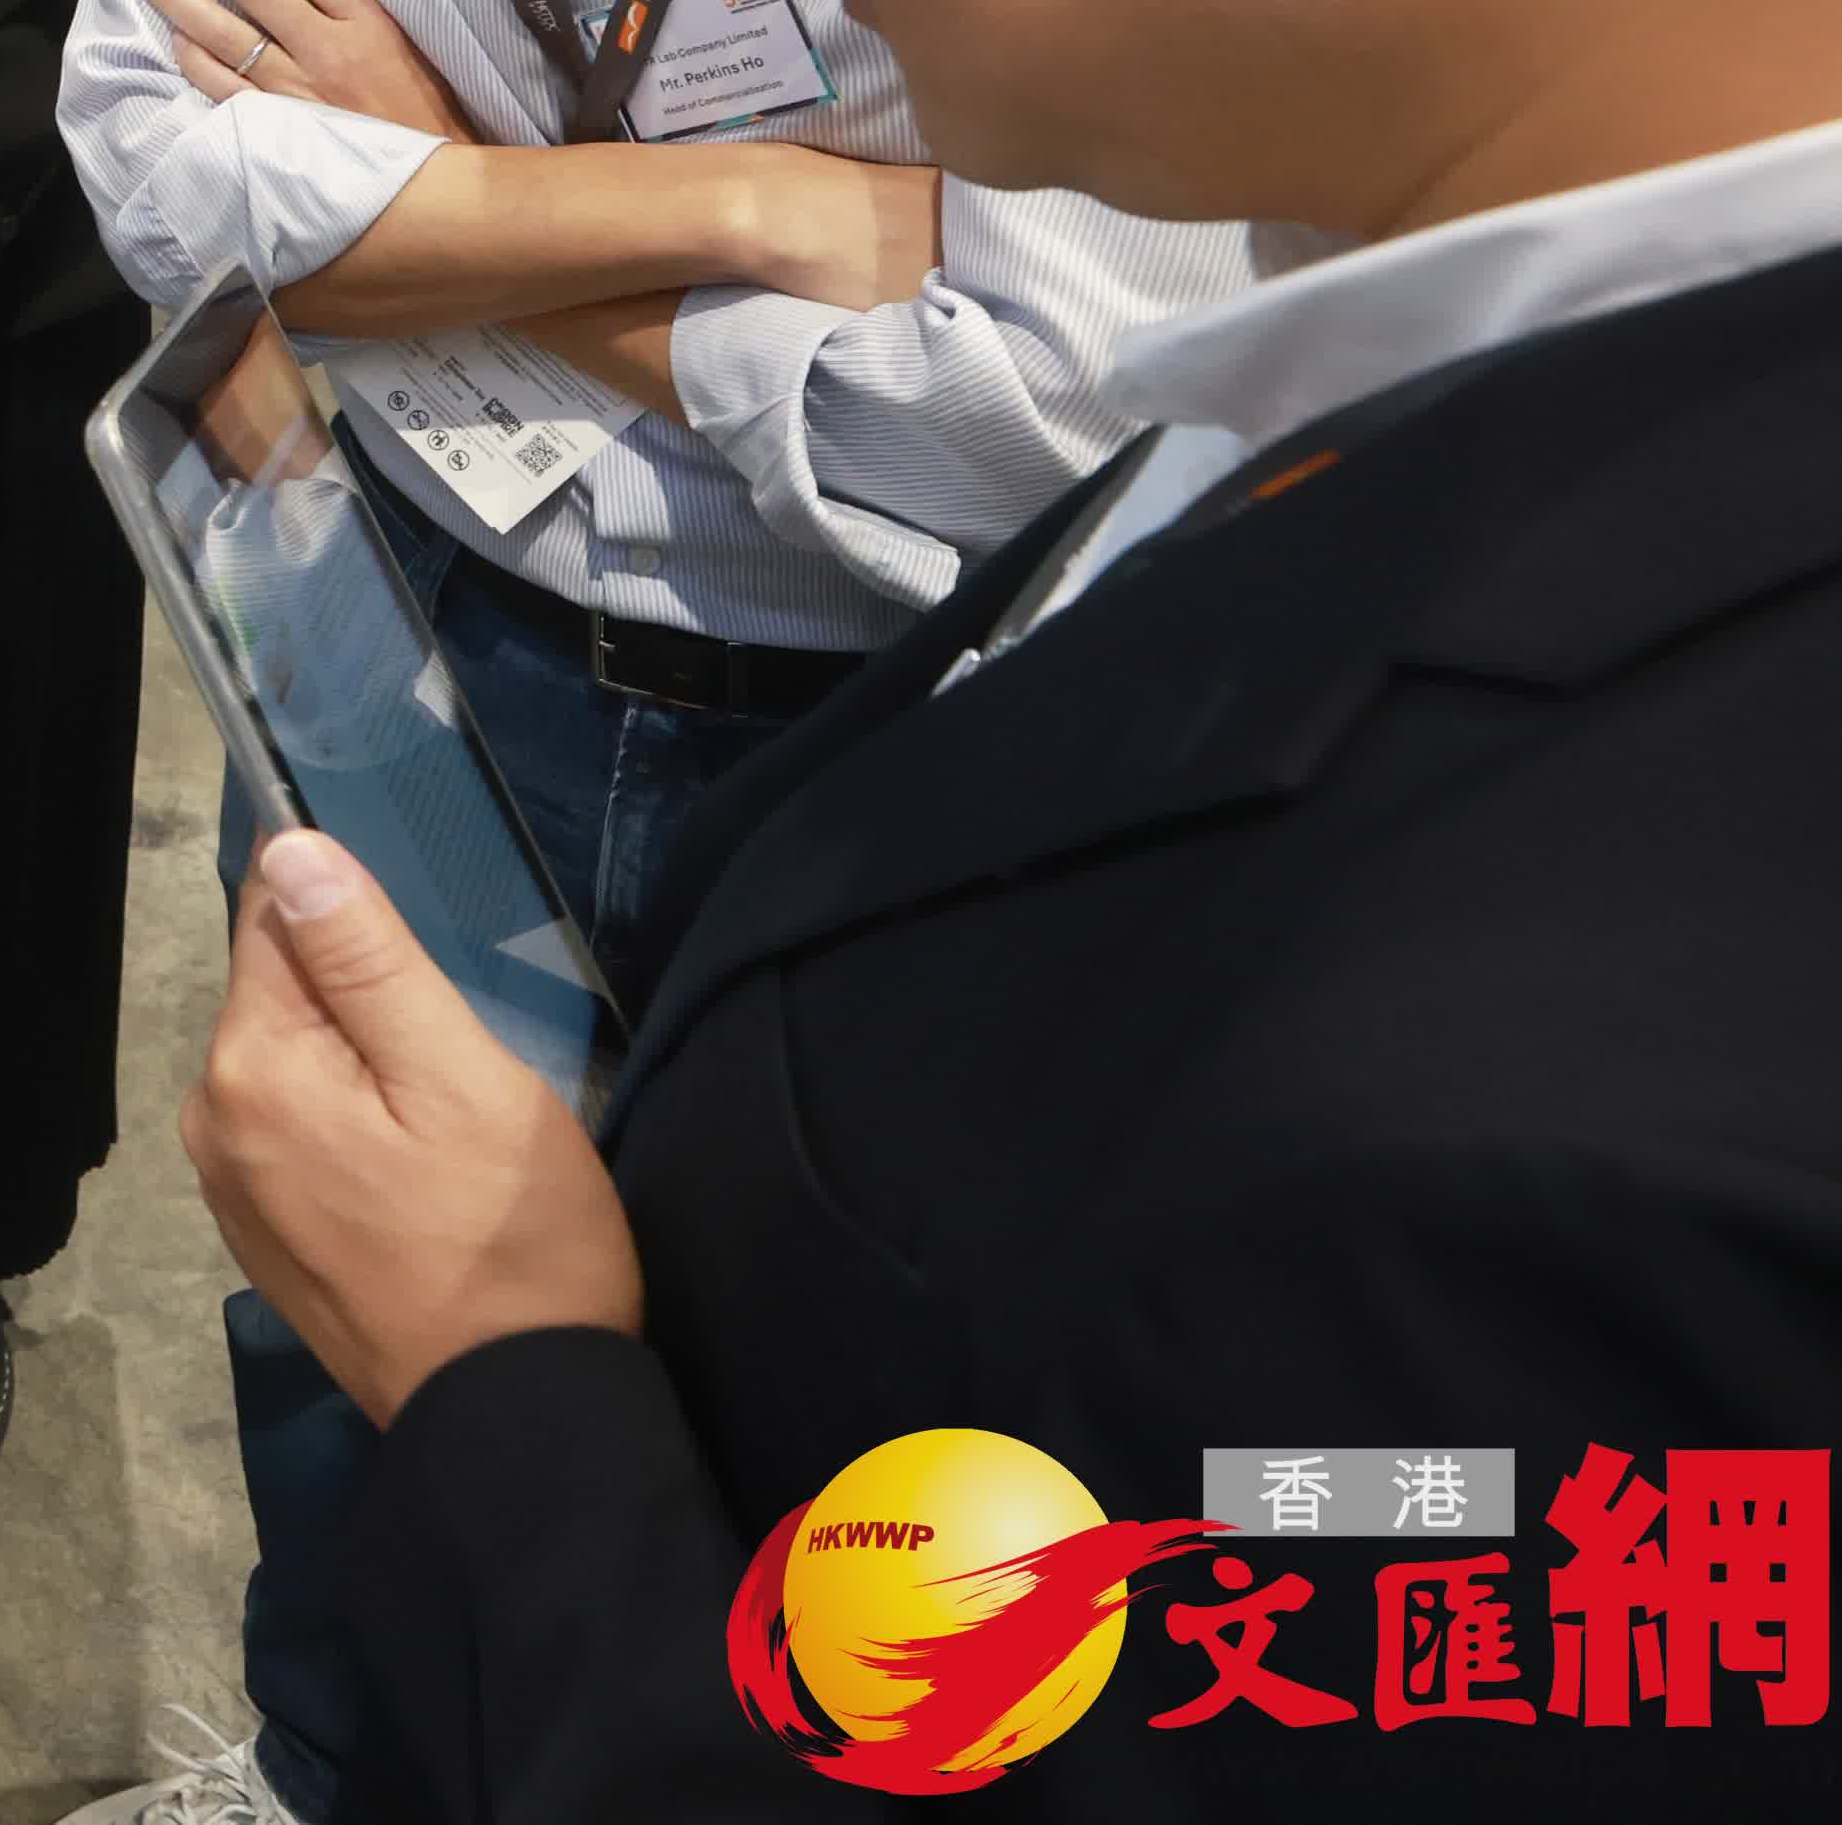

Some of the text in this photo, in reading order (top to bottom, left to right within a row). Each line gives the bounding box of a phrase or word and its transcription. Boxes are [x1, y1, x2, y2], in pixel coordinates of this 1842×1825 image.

[677, 36, 727, 61] Company
[728, 26, 769, 46] Limited
[659, 55, 765, 94] Mr. Perkins Ho
